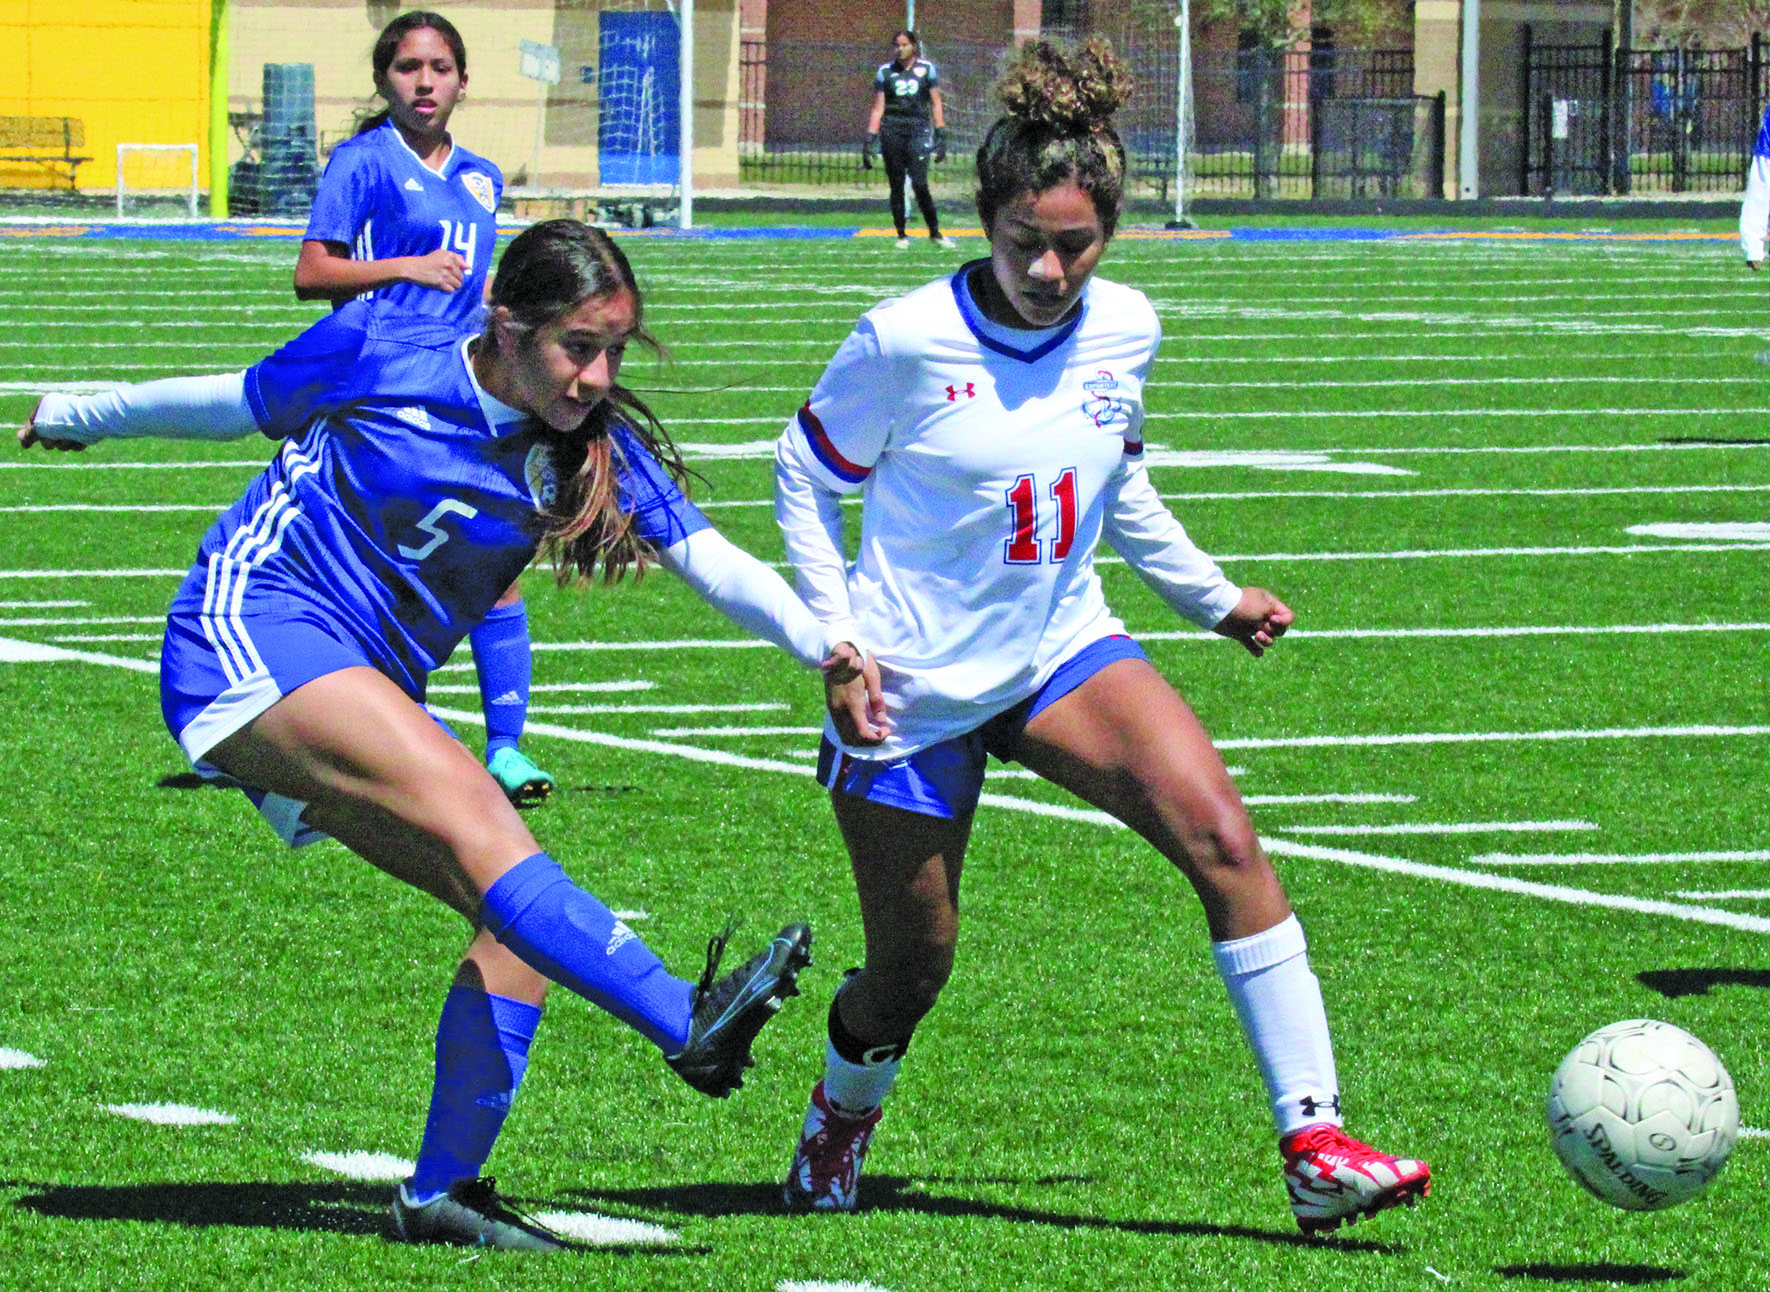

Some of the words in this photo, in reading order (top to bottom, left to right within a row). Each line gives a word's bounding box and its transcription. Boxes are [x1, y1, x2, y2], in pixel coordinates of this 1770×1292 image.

[895, 79, 919, 96] 23
[439, 220, 477, 275] 14
[397, 499, 478, 560] 5
[1003, 466, 1080, 565] 11
[1584, 1122, 1668, 1205] SPALDING
